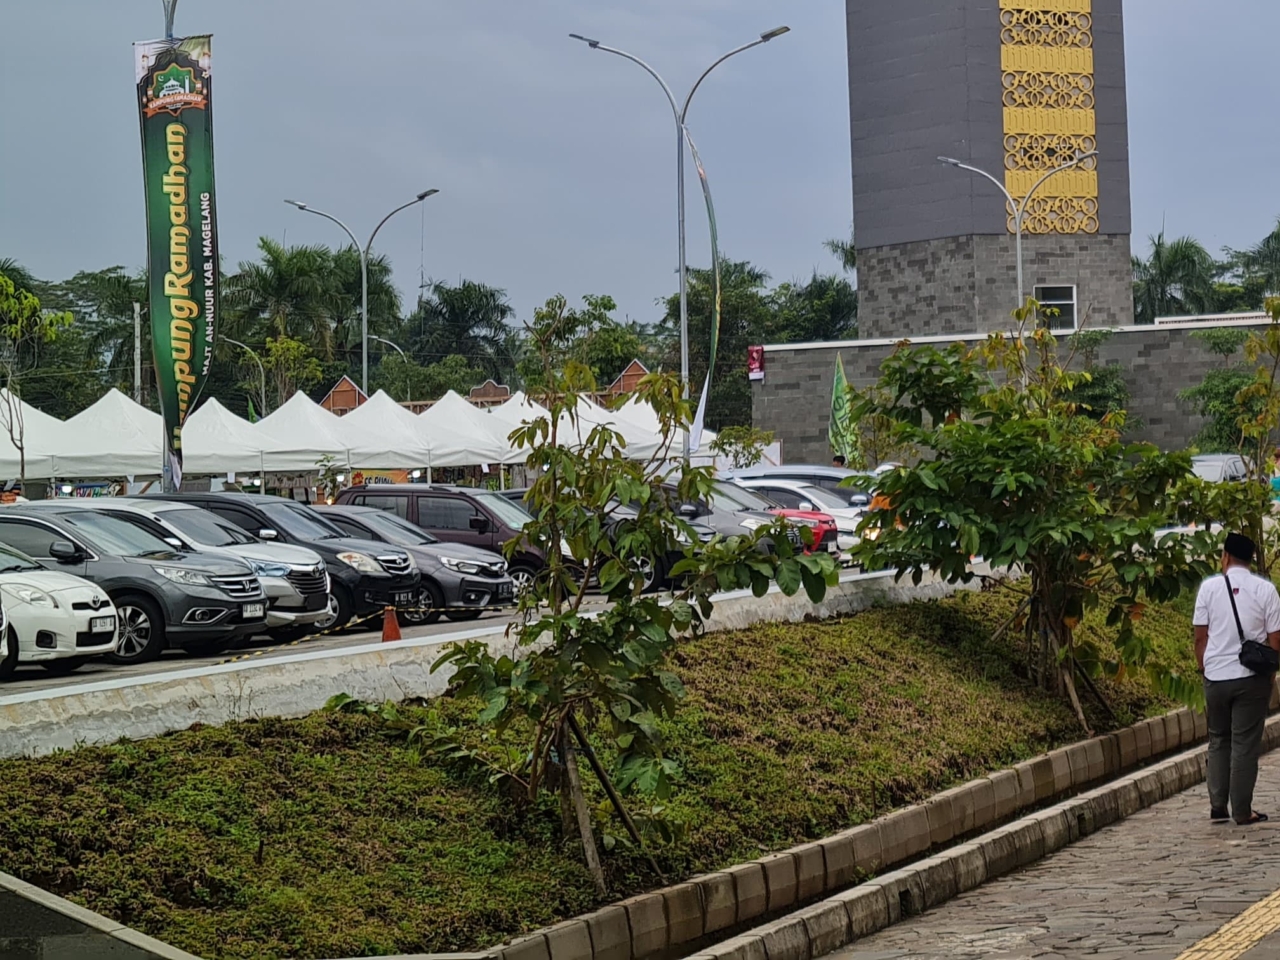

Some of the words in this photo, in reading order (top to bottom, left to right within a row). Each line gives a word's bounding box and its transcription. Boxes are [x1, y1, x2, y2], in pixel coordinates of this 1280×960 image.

[163, 122, 194, 297] Ramadhan
[200, 192, 213, 256] MAGELANG
[203, 259, 214, 286] KAB.
[204, 290, 215, 342] AN-NUUR
